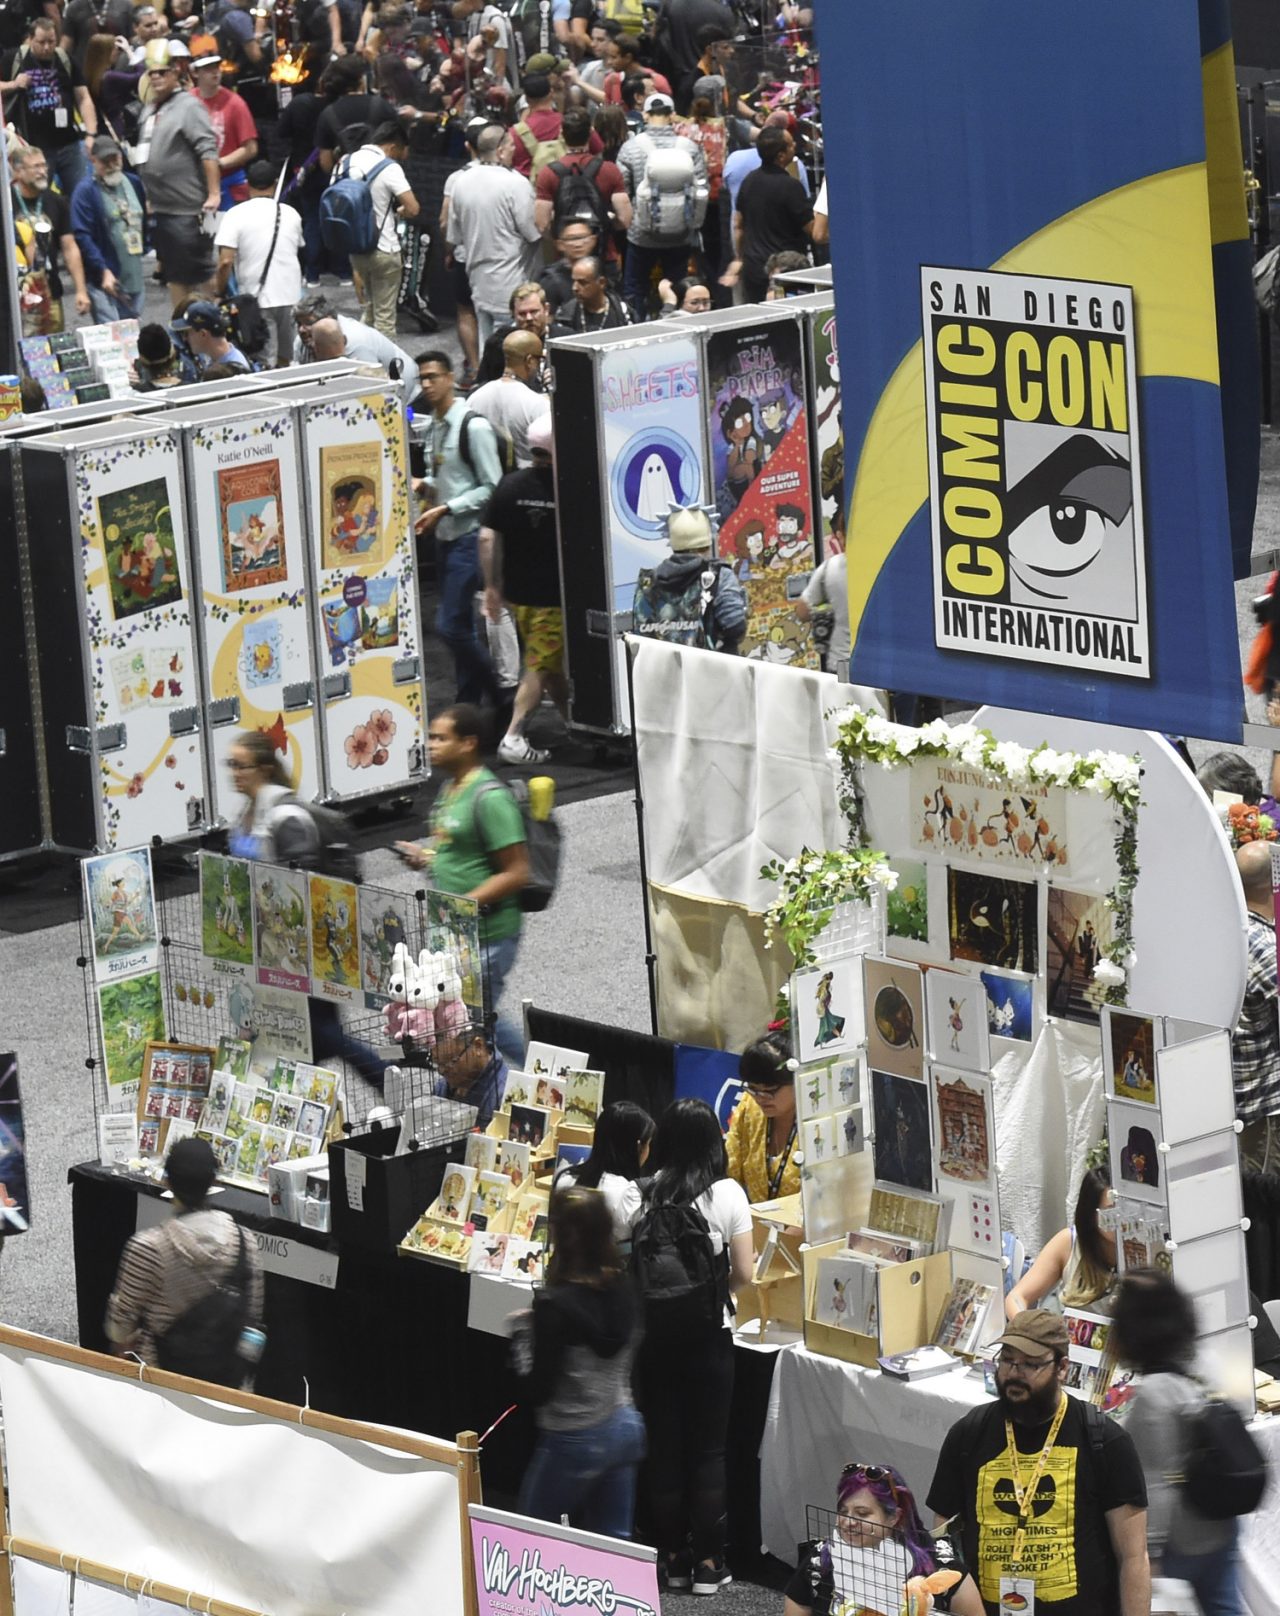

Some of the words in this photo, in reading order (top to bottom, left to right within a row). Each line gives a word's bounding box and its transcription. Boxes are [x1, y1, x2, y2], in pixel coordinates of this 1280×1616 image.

[930, 280, 992, 317] SAN
[1024, 290, 1126, 332] DIEGO
[605, 361, 699, 413] SHEETS
[1005, 330, 1128, 433] CON
[217, 451, 242, 464] Katie
[243, 443, 273, 458] O'Neill
[936, 323, 1006, 597] COMIC
[760, 475, 776, 485] OUR
[776, 471, 800, 482] SUPER
[760, 479, 801, 494] ADVENTURE
[942, 600, 1142, 664] INTERNATIONAL
[986, 1544, 1009, 1553] ROLL
[1010, 1544, 1033, 1553] TAT
[1024, 1526, 1057, 1536] TIMES
[482, 1536, 519, 1595] VAL
[985, 1553, 1010, 1562] LIGHT
[1040, 1562, 1048, 1571] IT
[518, 1548, 650, 1615] HOCHBERG
